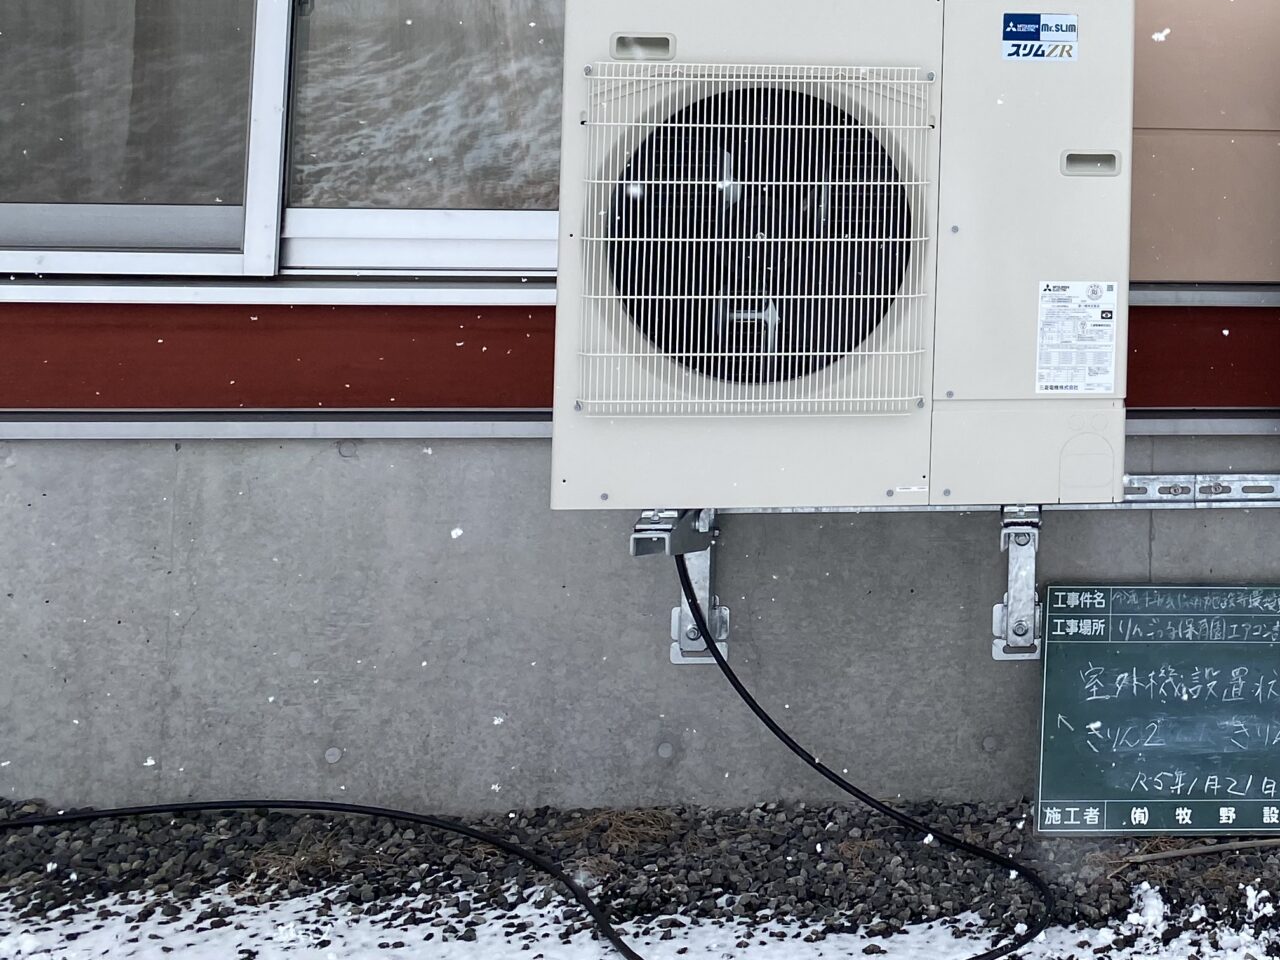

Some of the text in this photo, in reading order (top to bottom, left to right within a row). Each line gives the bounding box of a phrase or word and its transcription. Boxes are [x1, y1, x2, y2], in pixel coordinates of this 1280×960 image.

[1007, 43, 1073, 58] スリムZR
[1052, 591, 1106, 608] 工事件名
[1052, 619, 1106, 636] 工事場所
[1044, 807, 1100, 826] 施工者
